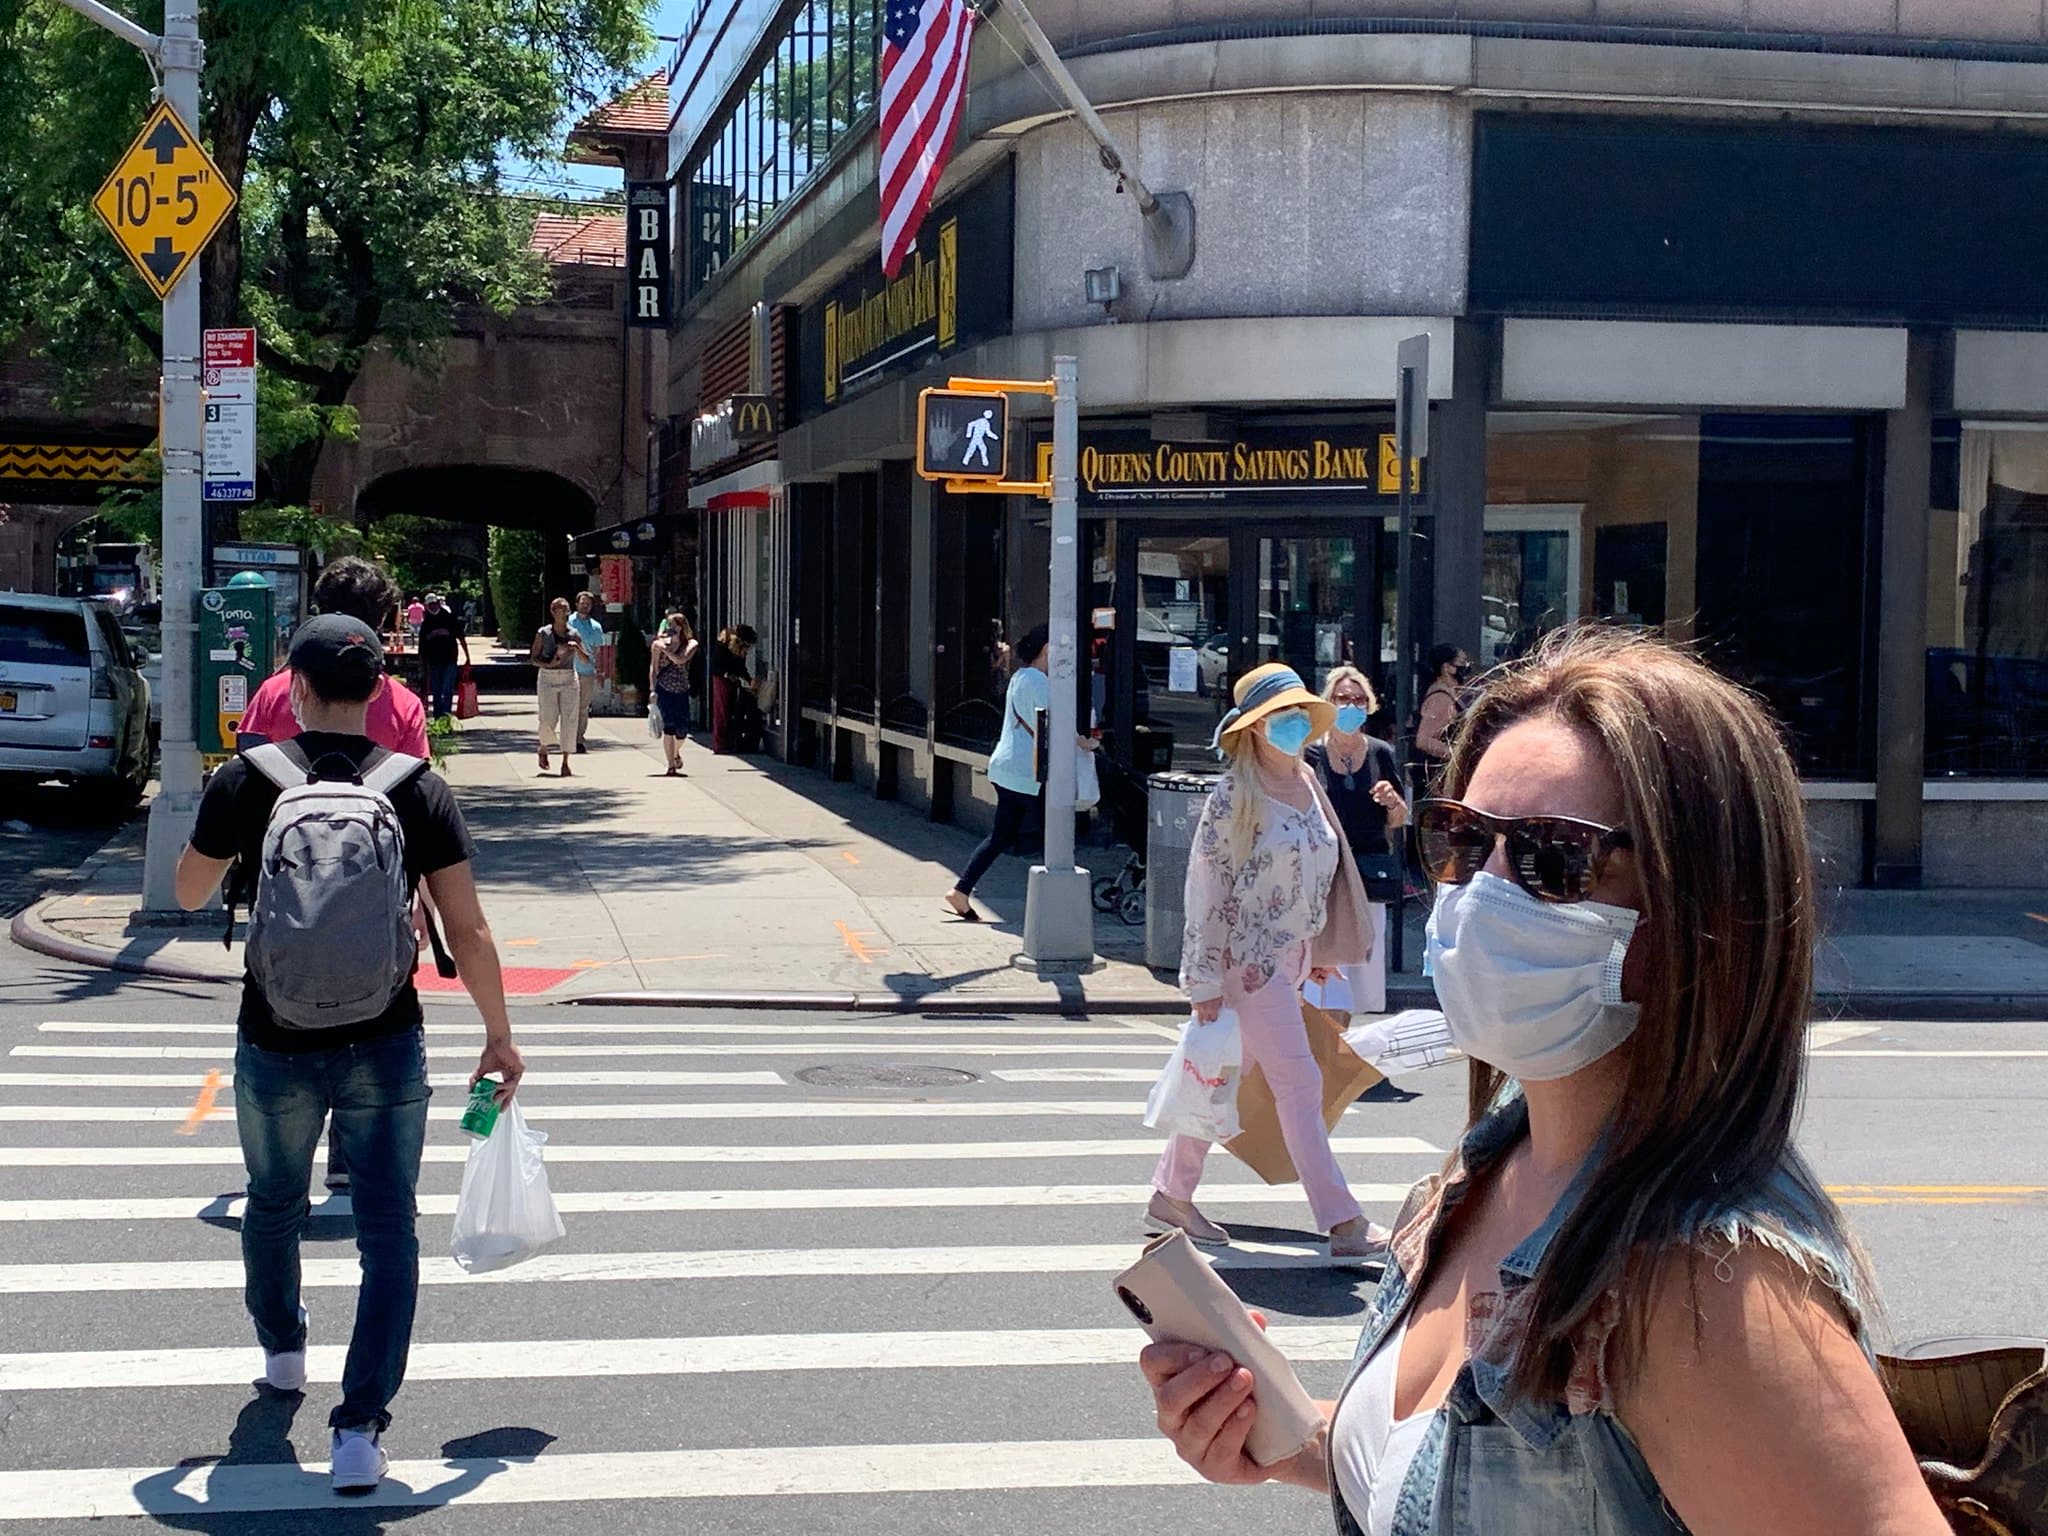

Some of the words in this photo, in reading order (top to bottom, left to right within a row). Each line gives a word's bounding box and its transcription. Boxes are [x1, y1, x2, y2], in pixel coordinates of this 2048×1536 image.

[637, 208, 660, 318] BAR
[208, 405, 217, 421] 3
[1081, 446, 1152, 493] QUEENS
[1155, 444, 1229, 482] COUNTY
[1233, 442, 1309, 481] SAVINGS
[1313, 440, 1369, 479] BANK
[210, 488, 242, 498] 463377
[236, 550, 277, 562] TITAN
